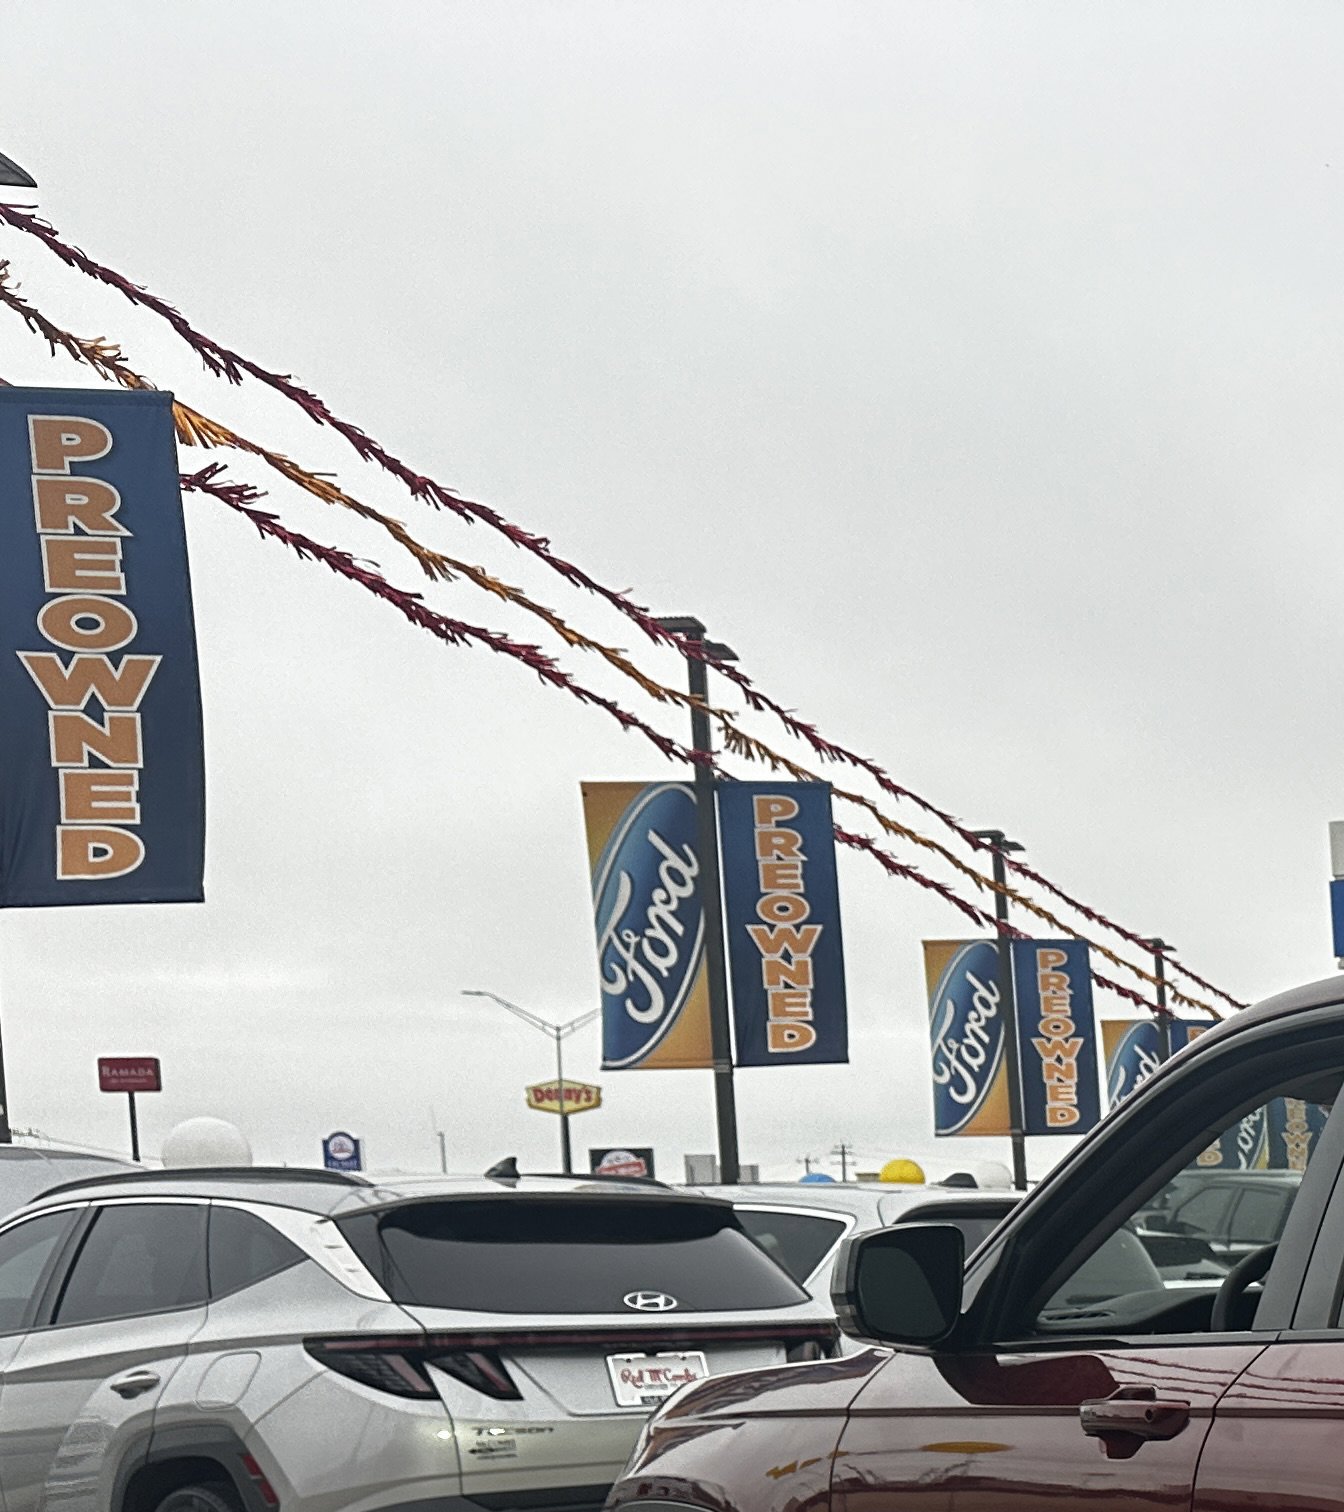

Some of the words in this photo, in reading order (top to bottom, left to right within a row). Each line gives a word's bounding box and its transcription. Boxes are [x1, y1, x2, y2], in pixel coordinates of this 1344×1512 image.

[16, 414, 163, 881] PREOWNED
[600, 829, 699, 1024] Ford
[745, 794, 823, 1053] PREOWNED
[932, 970, 1001, 1104] Ford
[1031, 948, 1084, 1127] PREOWNED
